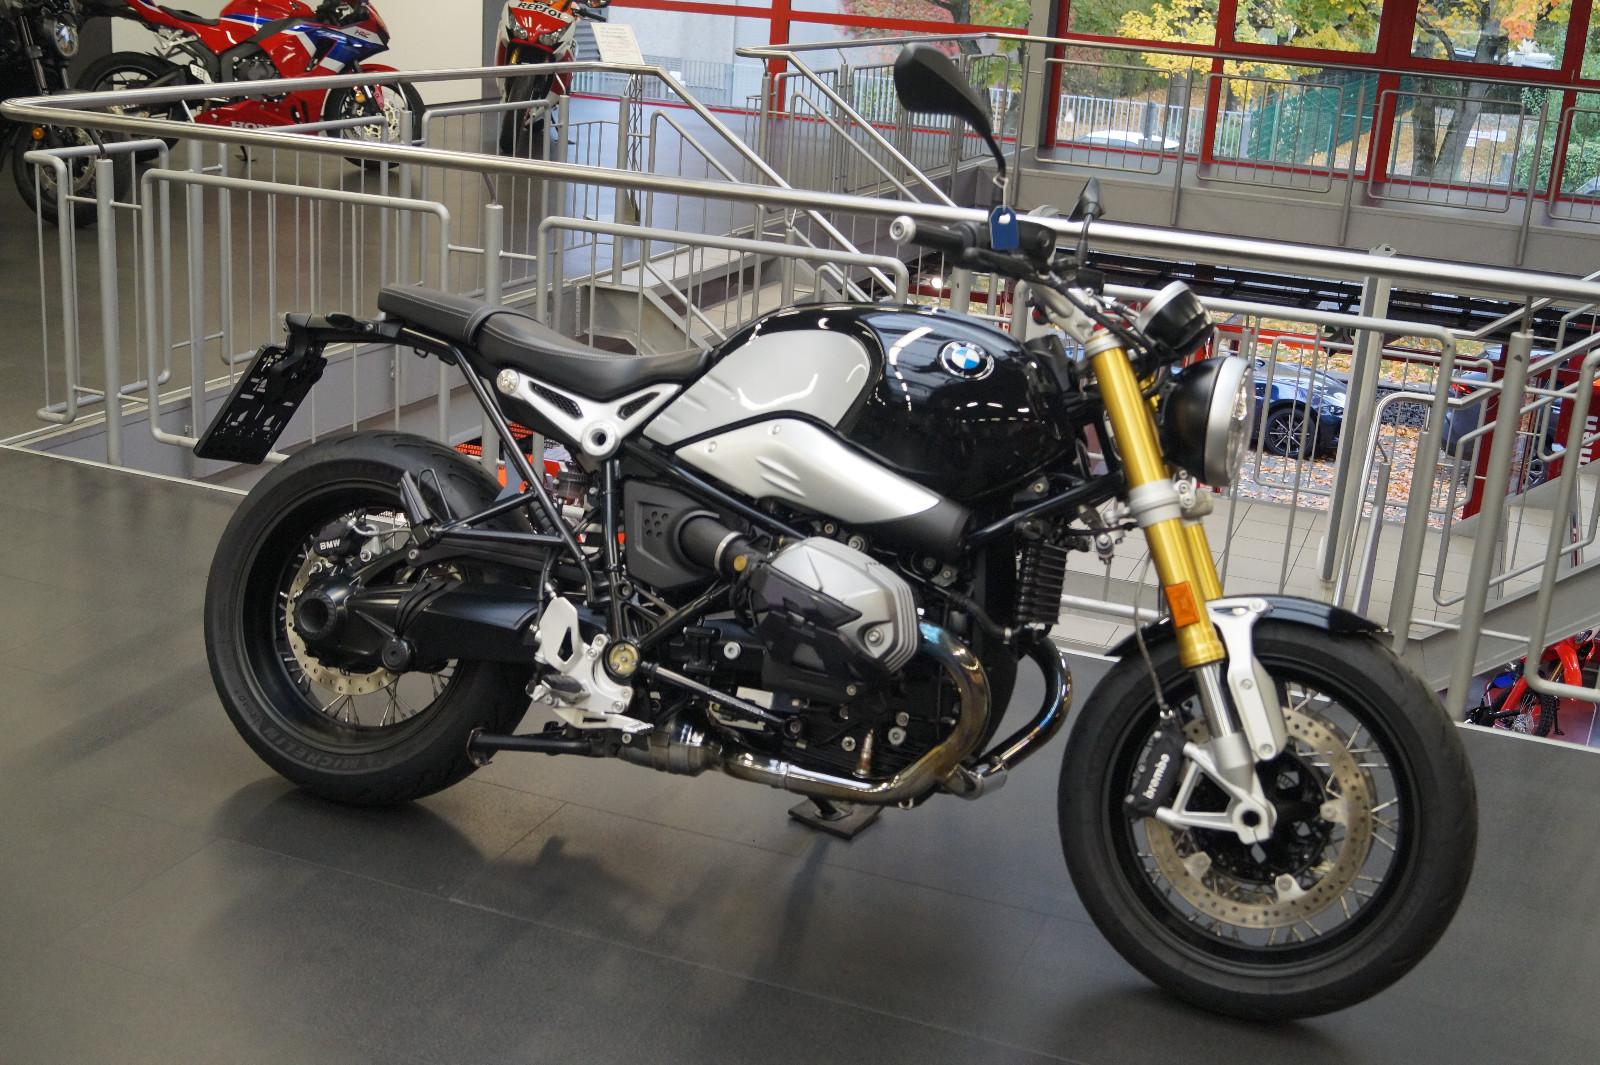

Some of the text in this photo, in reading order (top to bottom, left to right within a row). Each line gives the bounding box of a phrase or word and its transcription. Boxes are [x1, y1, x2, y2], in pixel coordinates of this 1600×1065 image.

[319, 538, 341, 551] BMW
[263, 726, 360, 770] MICHELIN
[1142, 753, 1170, 799] brembo
